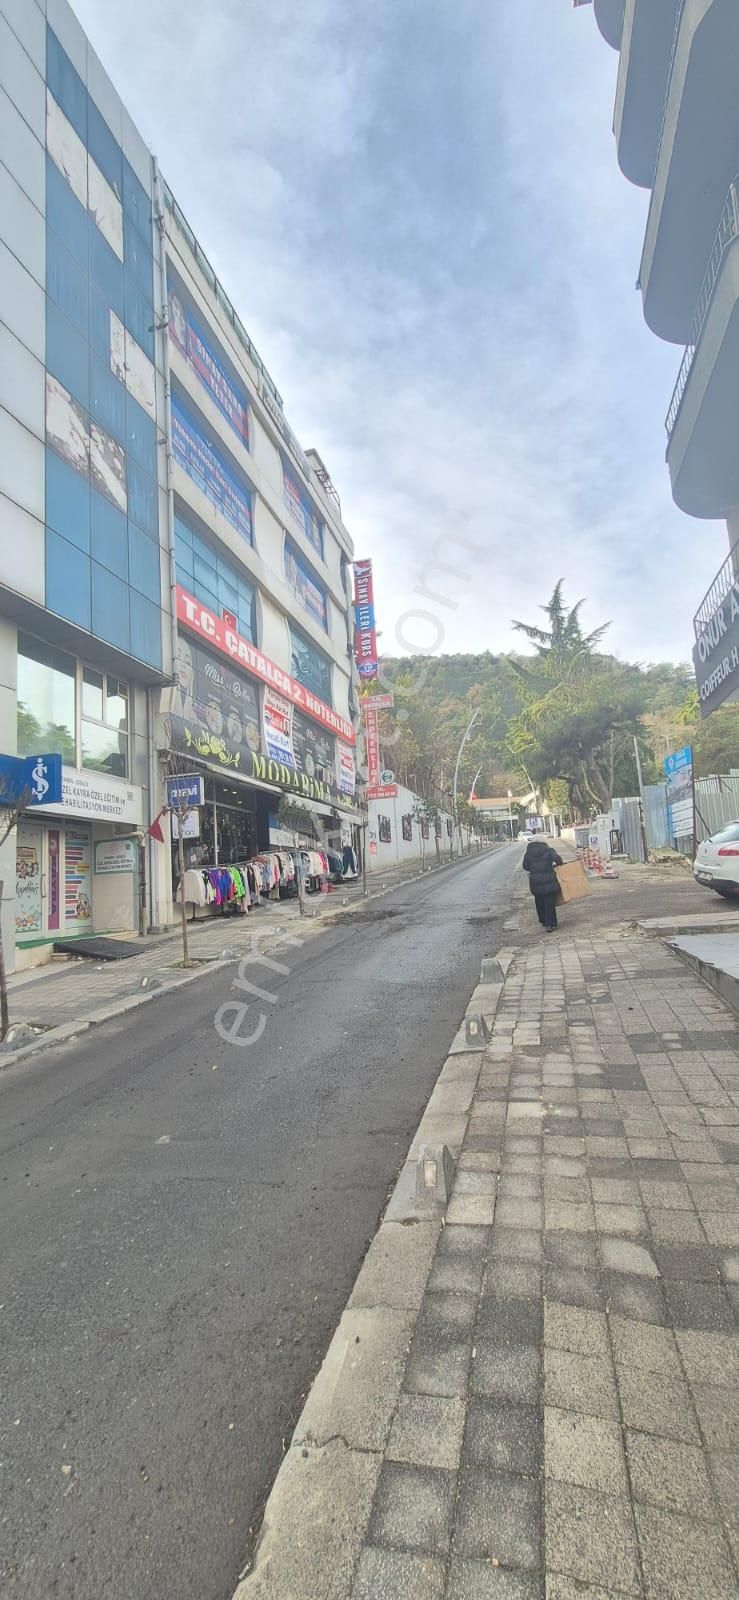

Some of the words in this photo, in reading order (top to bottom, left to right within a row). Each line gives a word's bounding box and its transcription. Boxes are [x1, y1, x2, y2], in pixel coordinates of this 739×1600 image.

[181, 595, 221, 641] T.C.
[698, 608, 728, 662] ONUR
[361, 632, 372, 657] KURS
